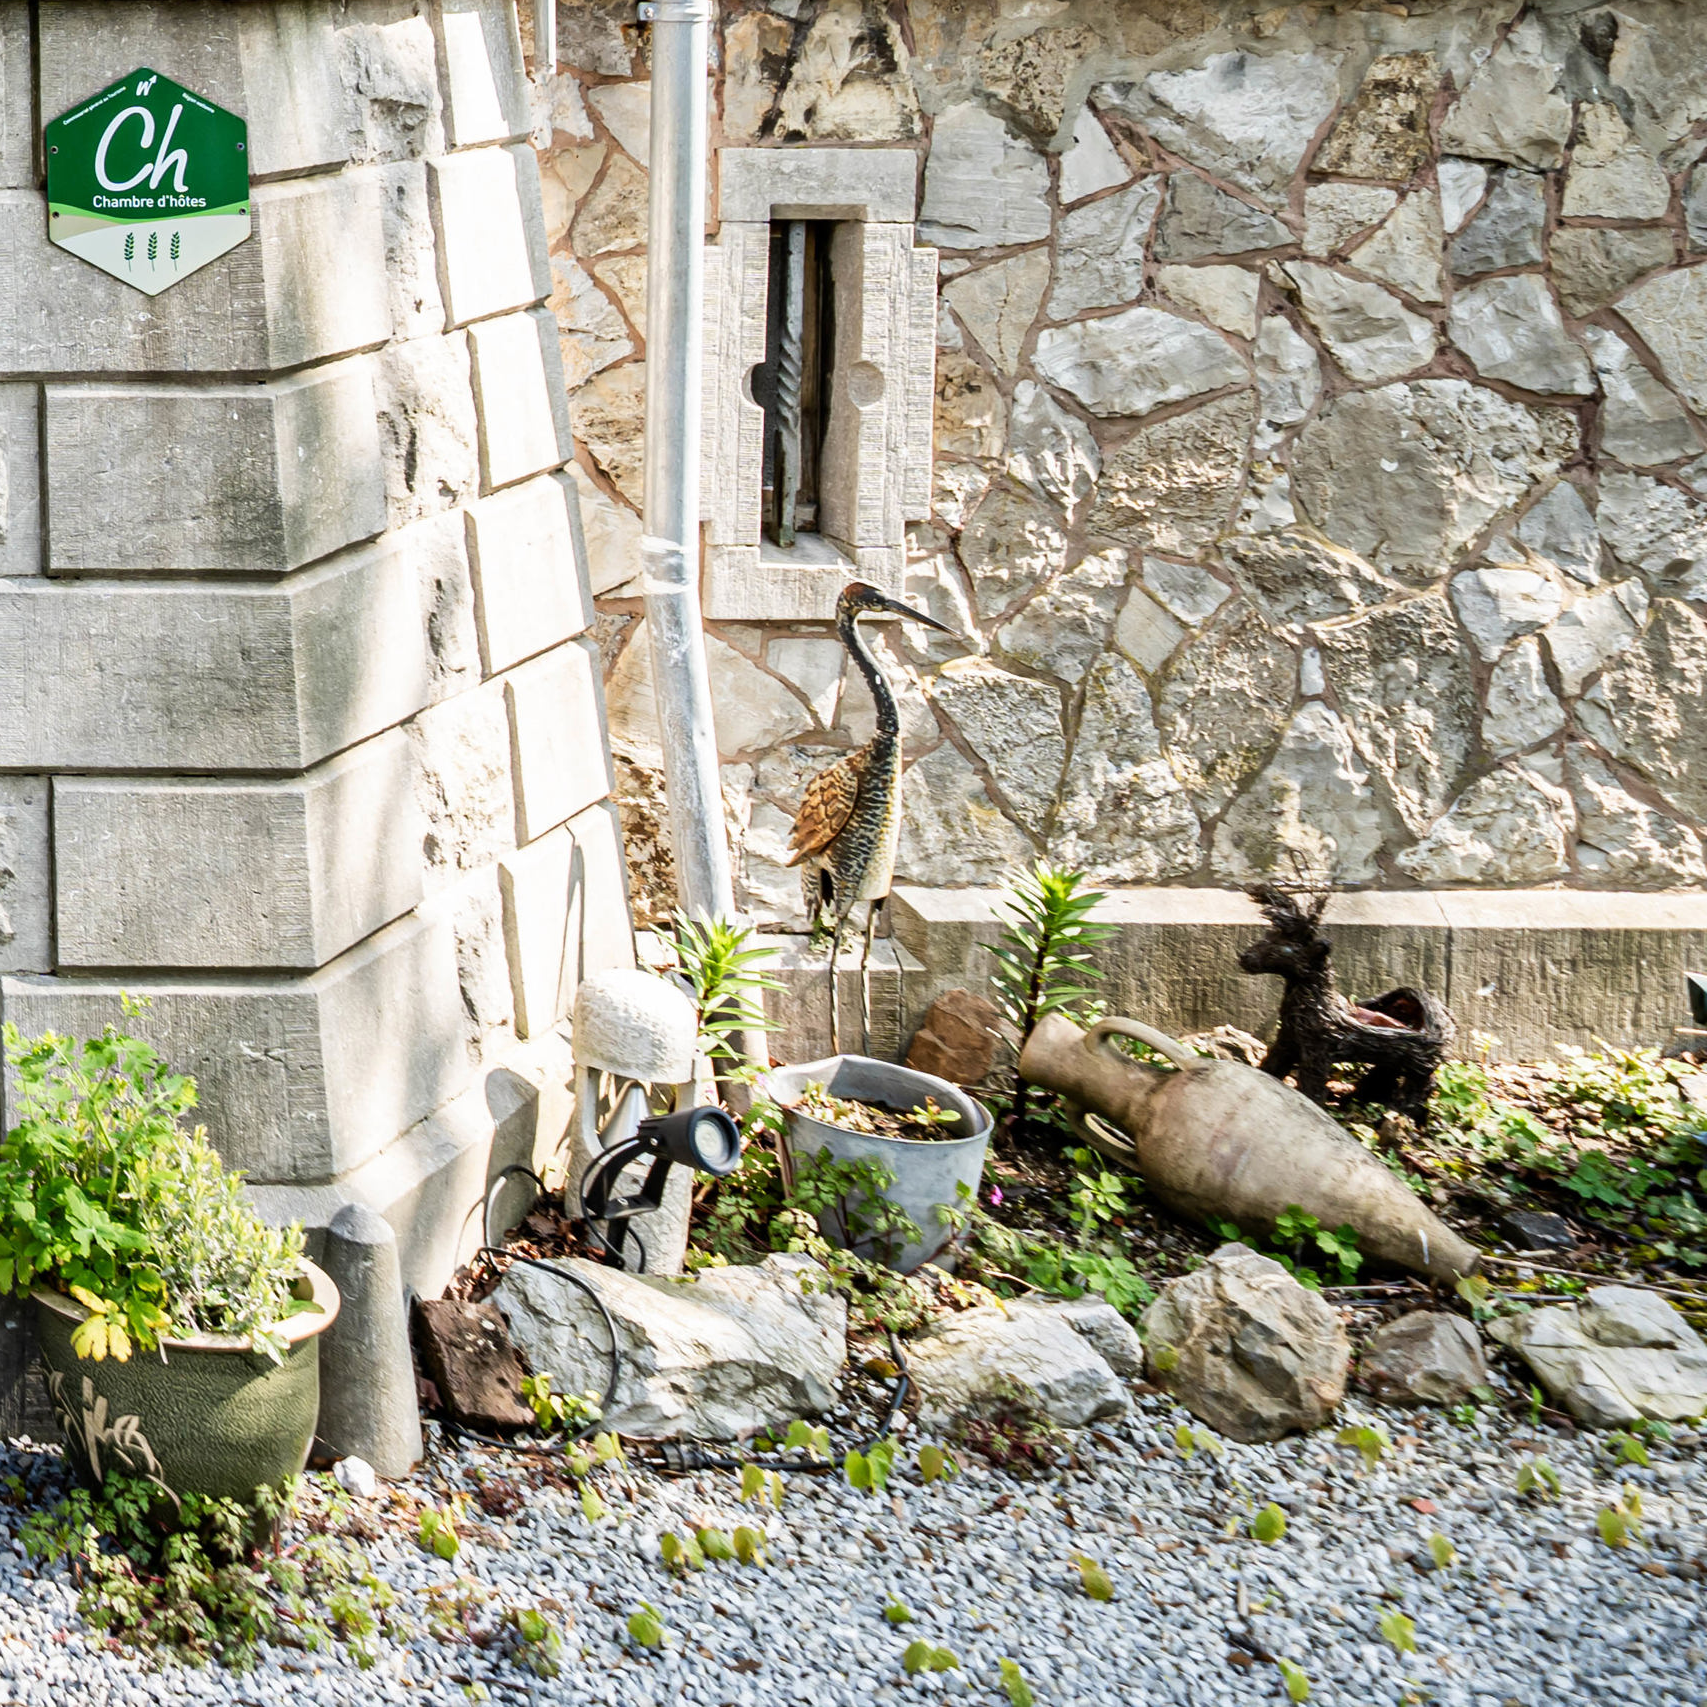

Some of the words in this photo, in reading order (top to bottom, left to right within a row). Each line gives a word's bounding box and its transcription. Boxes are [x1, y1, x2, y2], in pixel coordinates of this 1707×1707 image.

[95, 104, 189, 192] Ch
[93, 195, 154, 208] Chambre
[157, 194, 206, 208] d'hôtes
